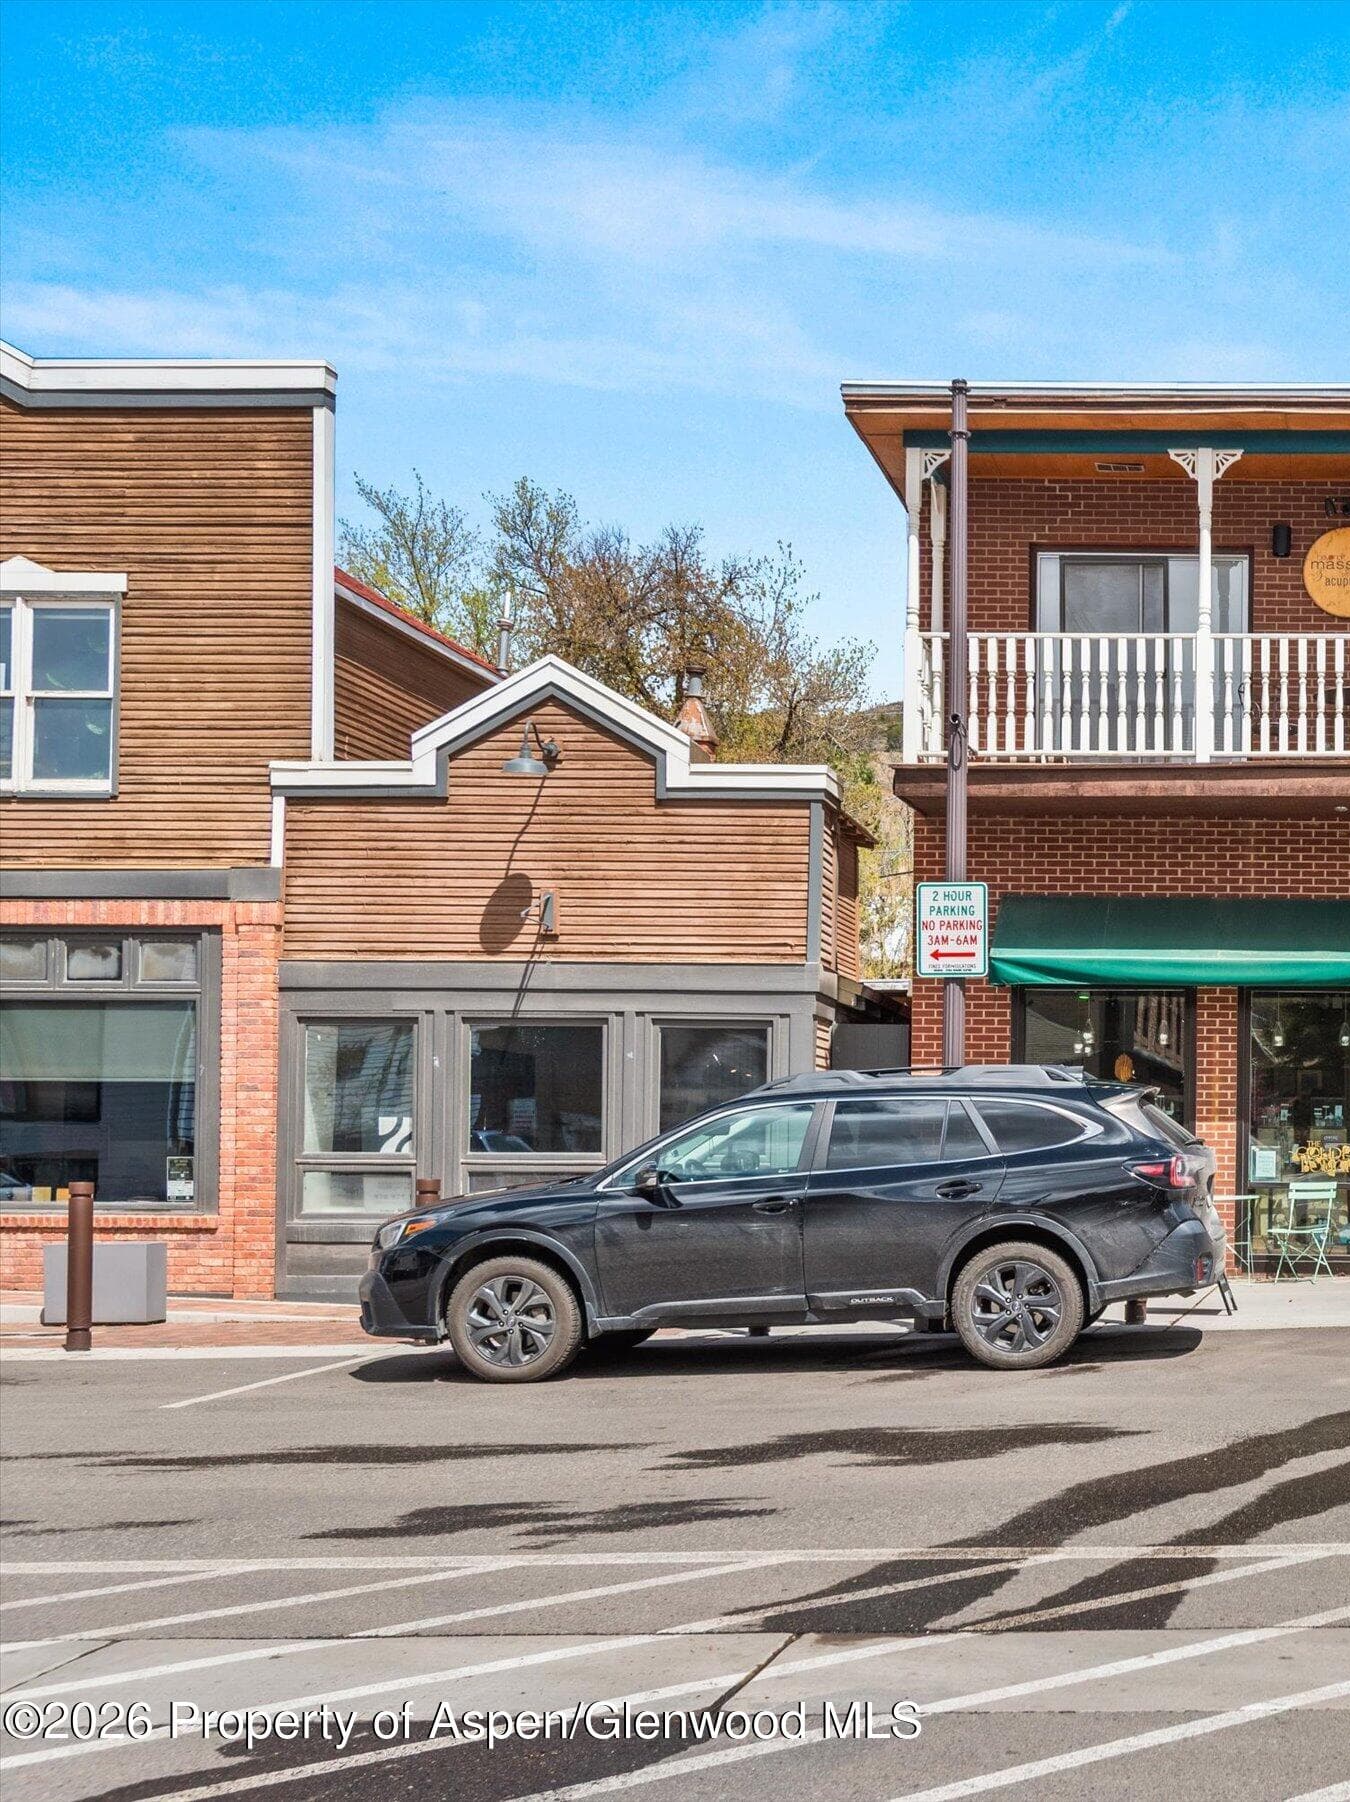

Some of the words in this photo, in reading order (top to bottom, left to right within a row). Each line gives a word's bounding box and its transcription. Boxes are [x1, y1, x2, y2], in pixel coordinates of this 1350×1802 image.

[932, 890, 939, 902] 2
[943, 890, 972, 902] HOUR
[929, 905, 976, 916] PARKING
[922, 919, 936, 931] NO
[939, 919, 983, 931] PARKING
[927, 934, 978, 946] 3AM-6AM
[1306, 1140, 1322, 1148] THE
